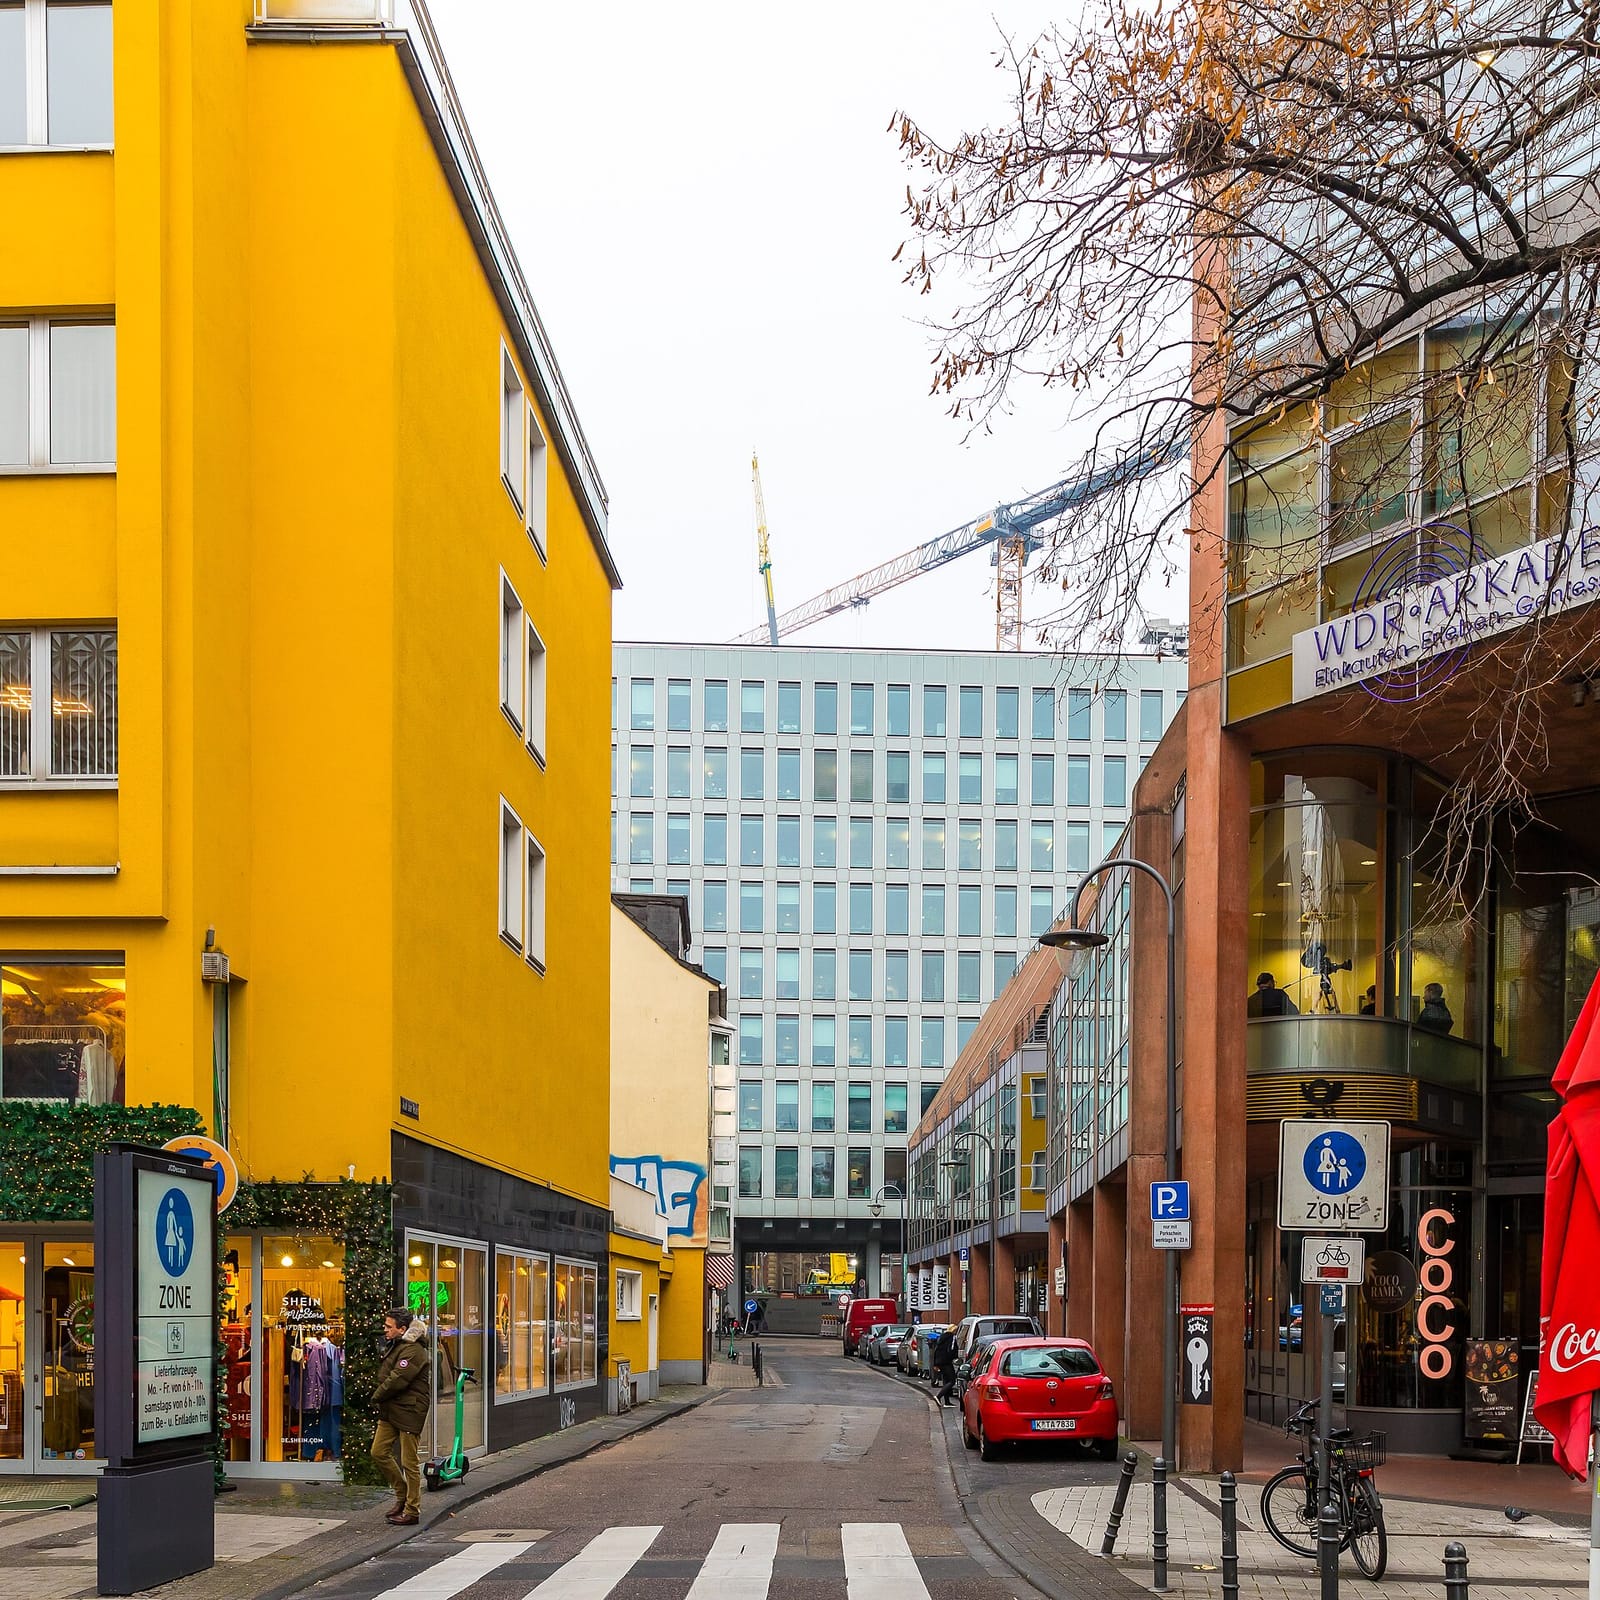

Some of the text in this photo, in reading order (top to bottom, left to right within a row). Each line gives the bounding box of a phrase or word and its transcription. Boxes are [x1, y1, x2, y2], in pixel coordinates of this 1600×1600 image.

[1314, 602, 1405, 662] WDR
[1158, 1187, 1177, 1215] P
[1305, 1202, 1361, 1220] ZONE
[1374, 1274, 1400, 1287] COCO
[159, 1284, 192, 1309] ZONE
[1371, 1285, 1403, 1297] RAMEN
[282, 1297, 321, 1306] SHEIN
[1549, 1322, 1600, 1373] Coc
[154, 1364, 197, 1377] Lieferfahrzeuge
[171, 1383, 182, 1393] von
[144, 1400, 171, 1413] samstags
[172, 1399, 183, 1410] von
[141, 1420, 155, 1431] zum
[175, 1412, 198, 1426] Entladen
[200, 1410, 208, 1422] frei
[1056, 1420, 1075, 1428] 7838
